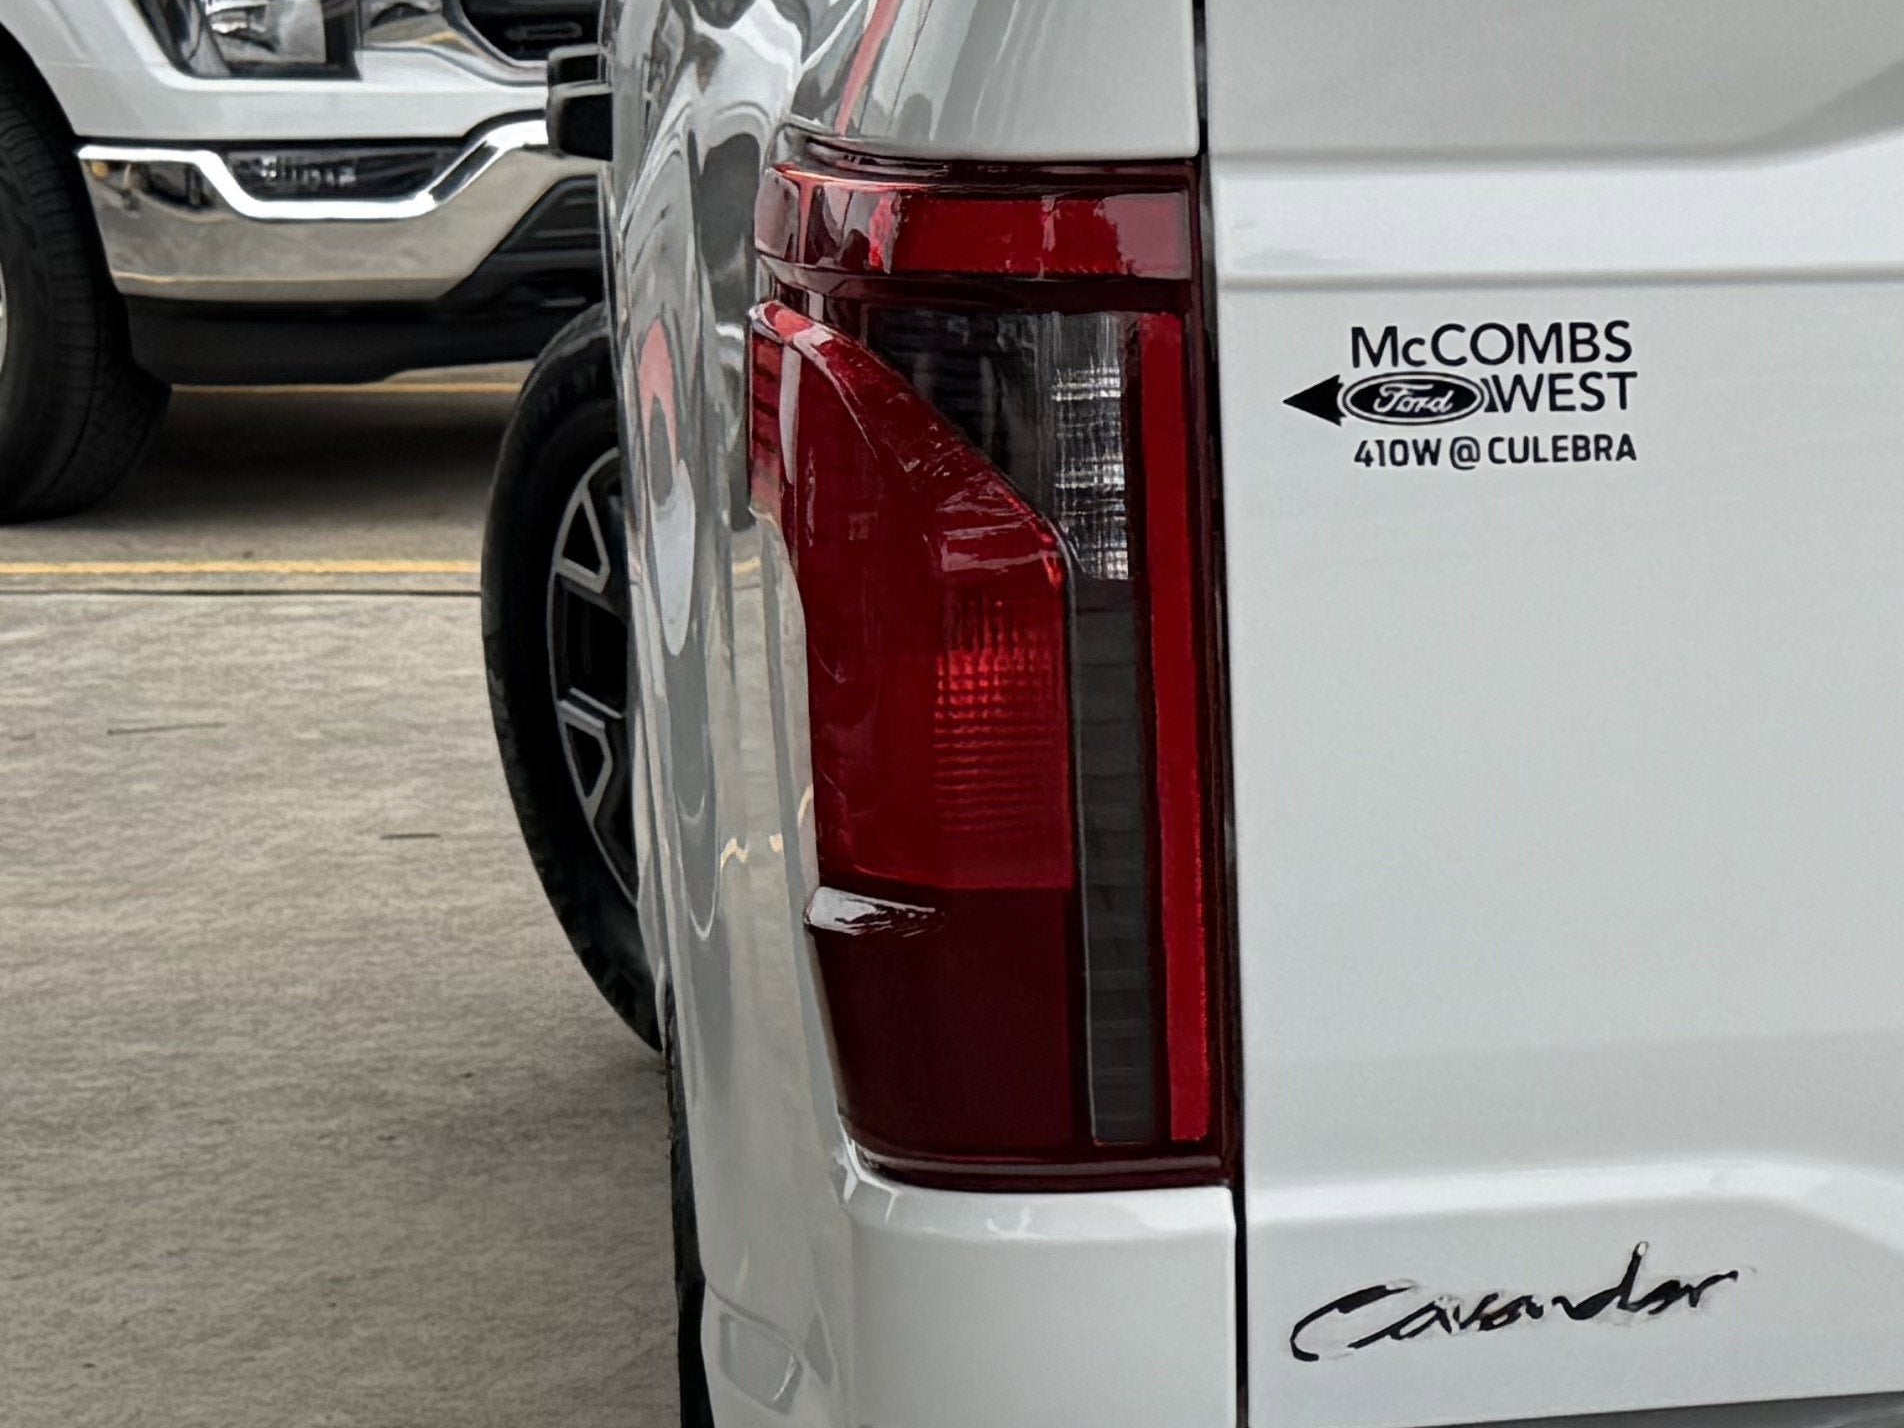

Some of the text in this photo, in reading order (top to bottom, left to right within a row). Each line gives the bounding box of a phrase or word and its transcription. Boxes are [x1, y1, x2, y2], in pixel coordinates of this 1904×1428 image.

[1351, 320, 1632, 368] McCOMBS
[1373, 372, 1637, 414] Ford WEST
[1488, 433, 1637, 464] CULEBRA
